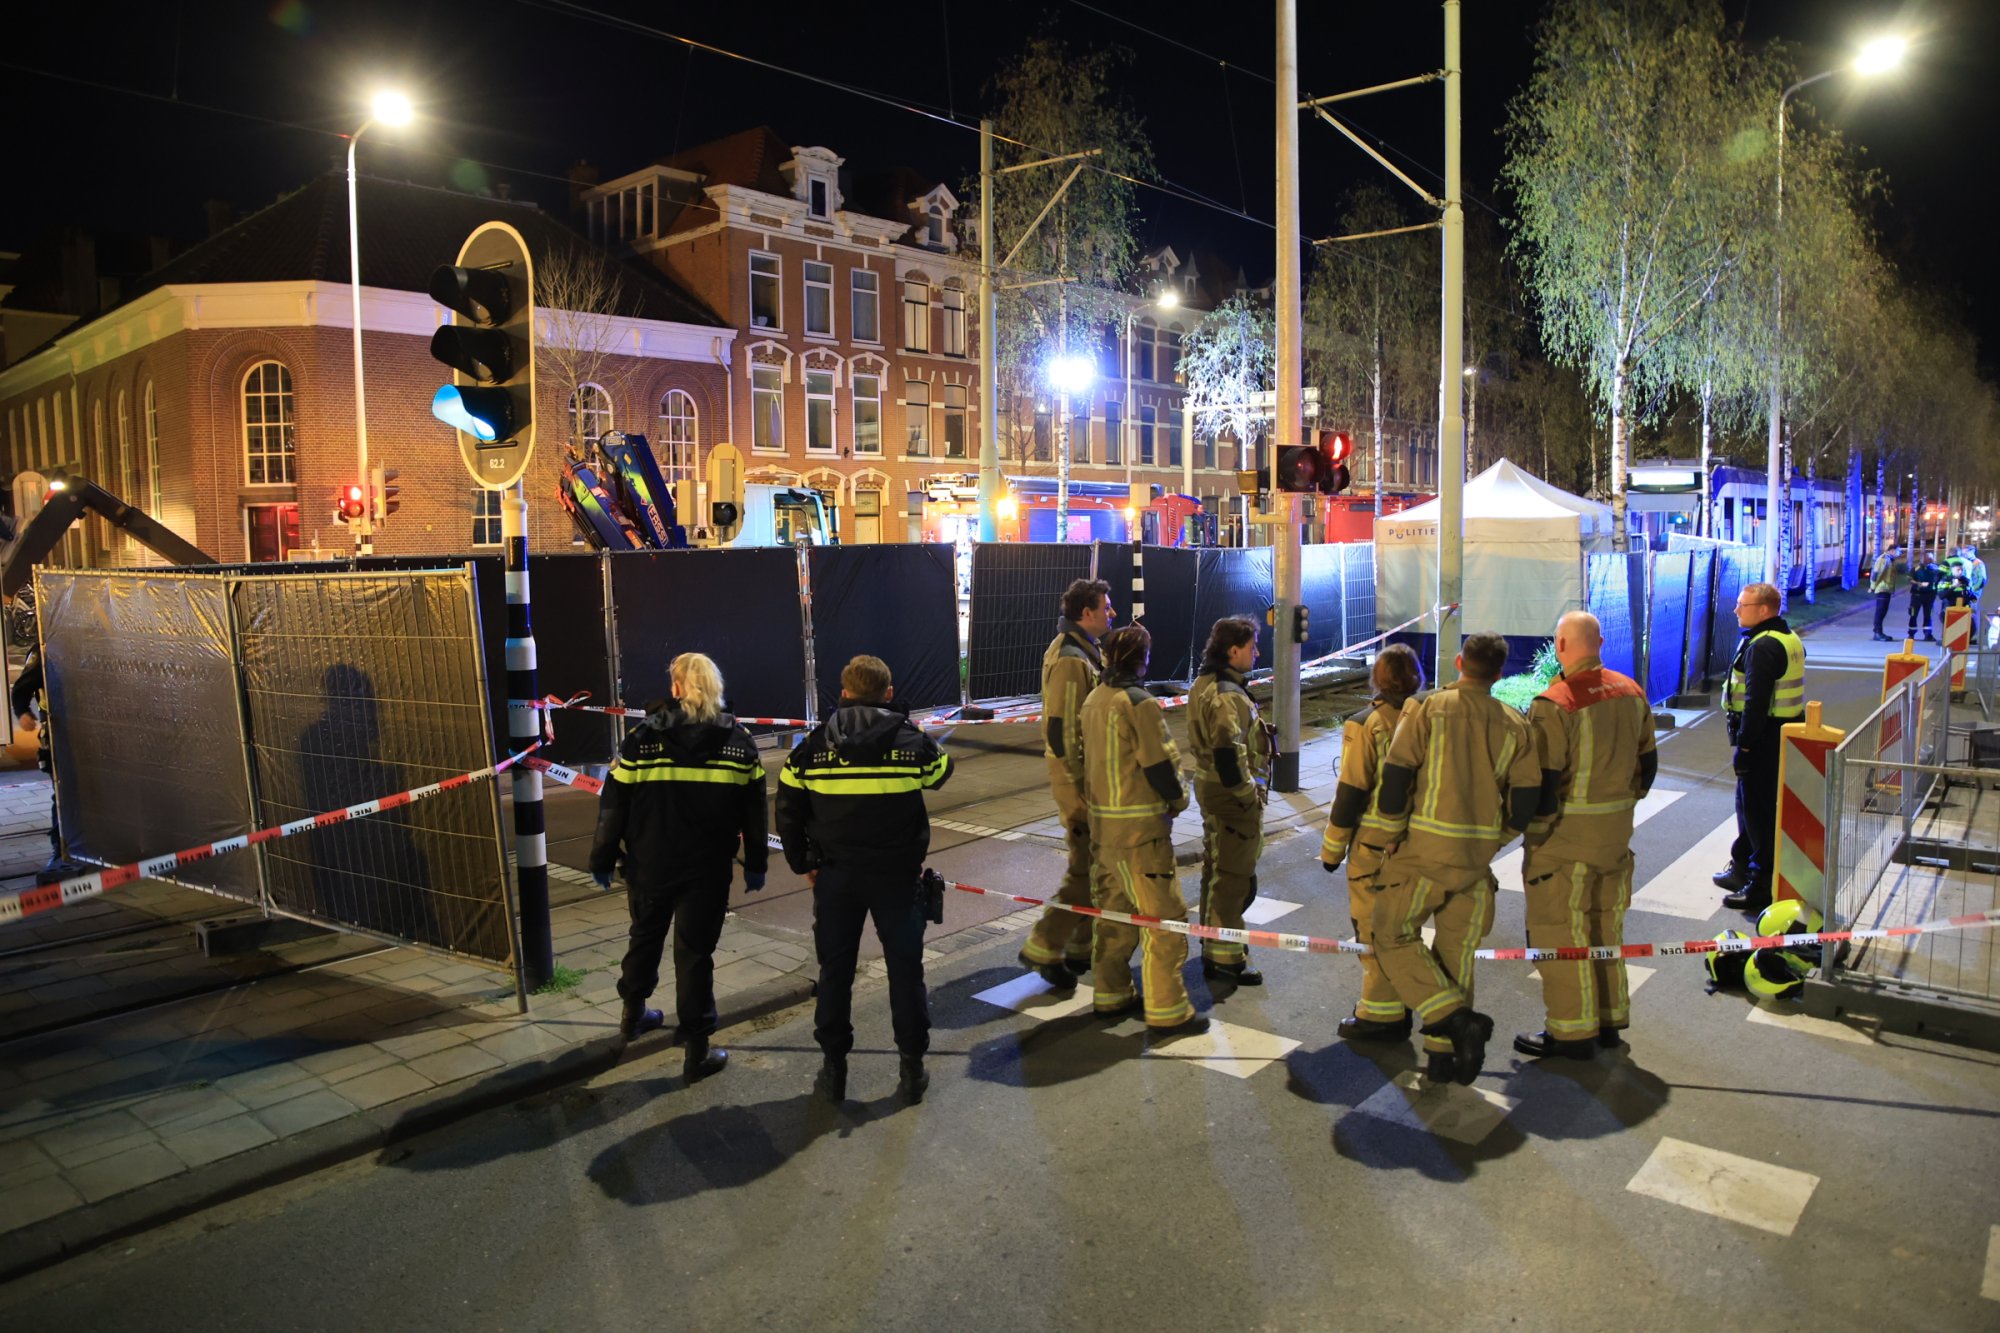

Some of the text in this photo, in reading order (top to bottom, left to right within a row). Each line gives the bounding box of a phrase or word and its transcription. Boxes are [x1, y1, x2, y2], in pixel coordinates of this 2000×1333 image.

[489, 458, 505, 469] 62.2
[649, 505, 668, 545] FASSI
[547, 766, 569, 779] NIET
[289, 807, 372, 835] NIET BETREDEN
[214, 842, 240, 856] NIET
[64, 882, 92, 897] NIET
[1660, 944, 1717, 957] BETREDEN
[1720, 943, 1743, 952] NIET
[1532, 950, 1588, 961] BETREDEN
[1590, 950, 1614, 959] NIET
